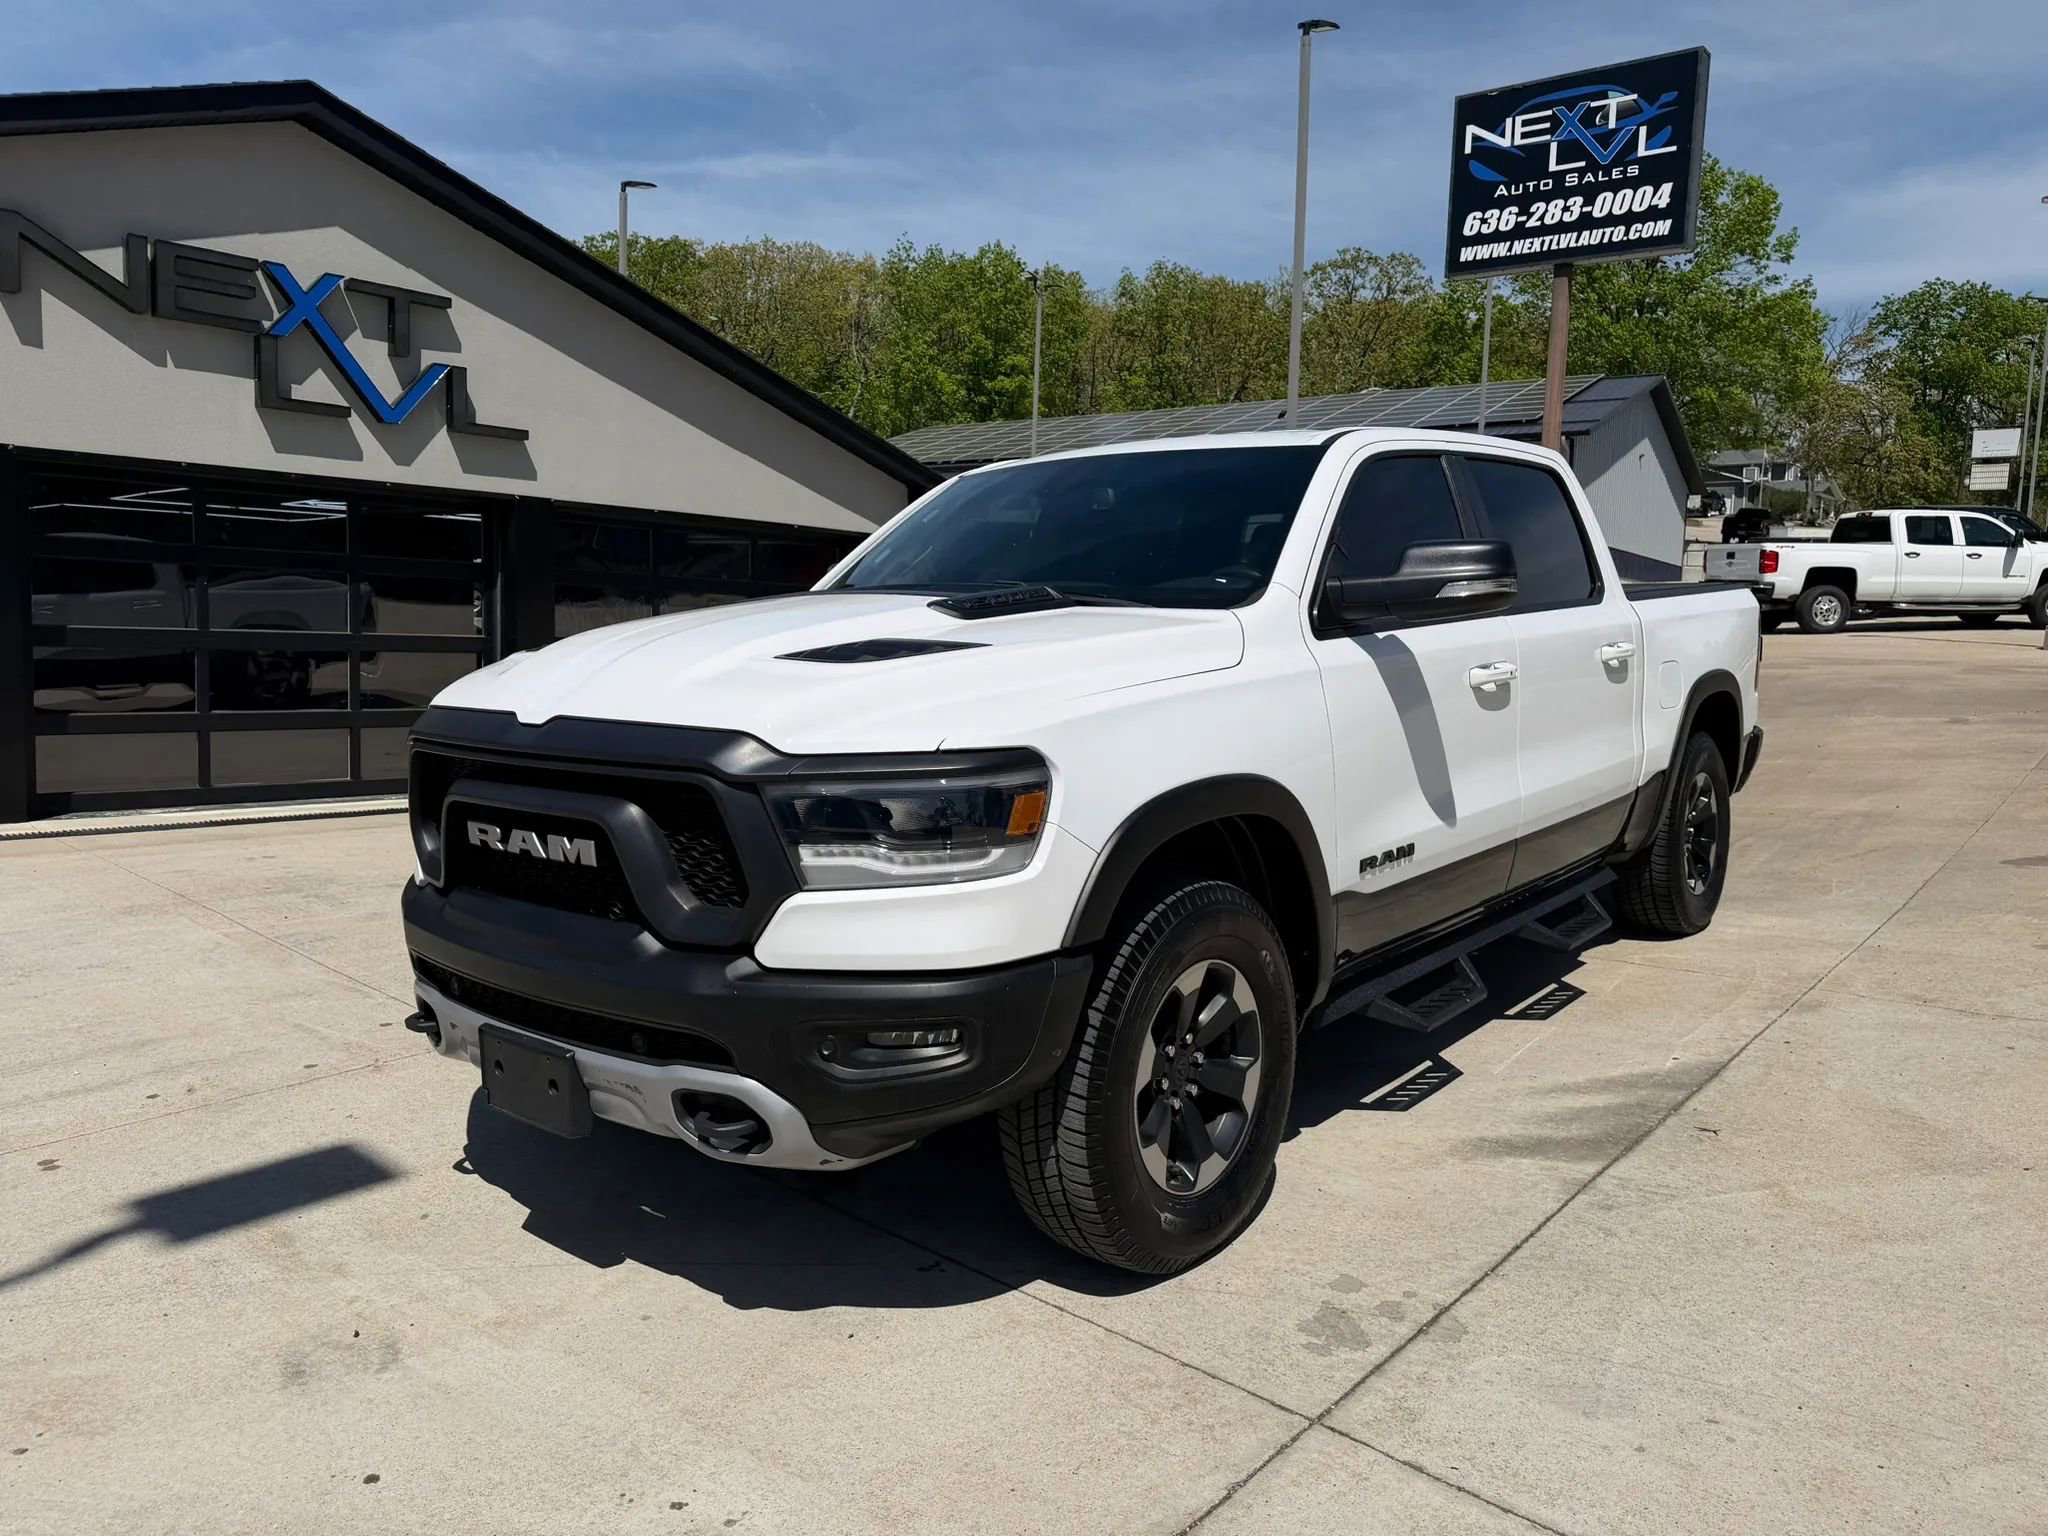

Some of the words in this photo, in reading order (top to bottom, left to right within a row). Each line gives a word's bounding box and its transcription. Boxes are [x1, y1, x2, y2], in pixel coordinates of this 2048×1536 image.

[1464, 93, 1638, 154] NEXT
[1549, 125, 1677, 172] LVL
[1494, 179, 1553, 198] AUTO
[1564, 165, 1640, 187] SALES
[1462, 182, 1674, 237] 636-283-0004
[1459, 219, 1673, 262] WWW.NEXTLVLAUTO.COM
[0, 207, 452, 358] NEXT
[467, 820, 598, 868] RAM
[1359, 842, 1415, 874] RAM
